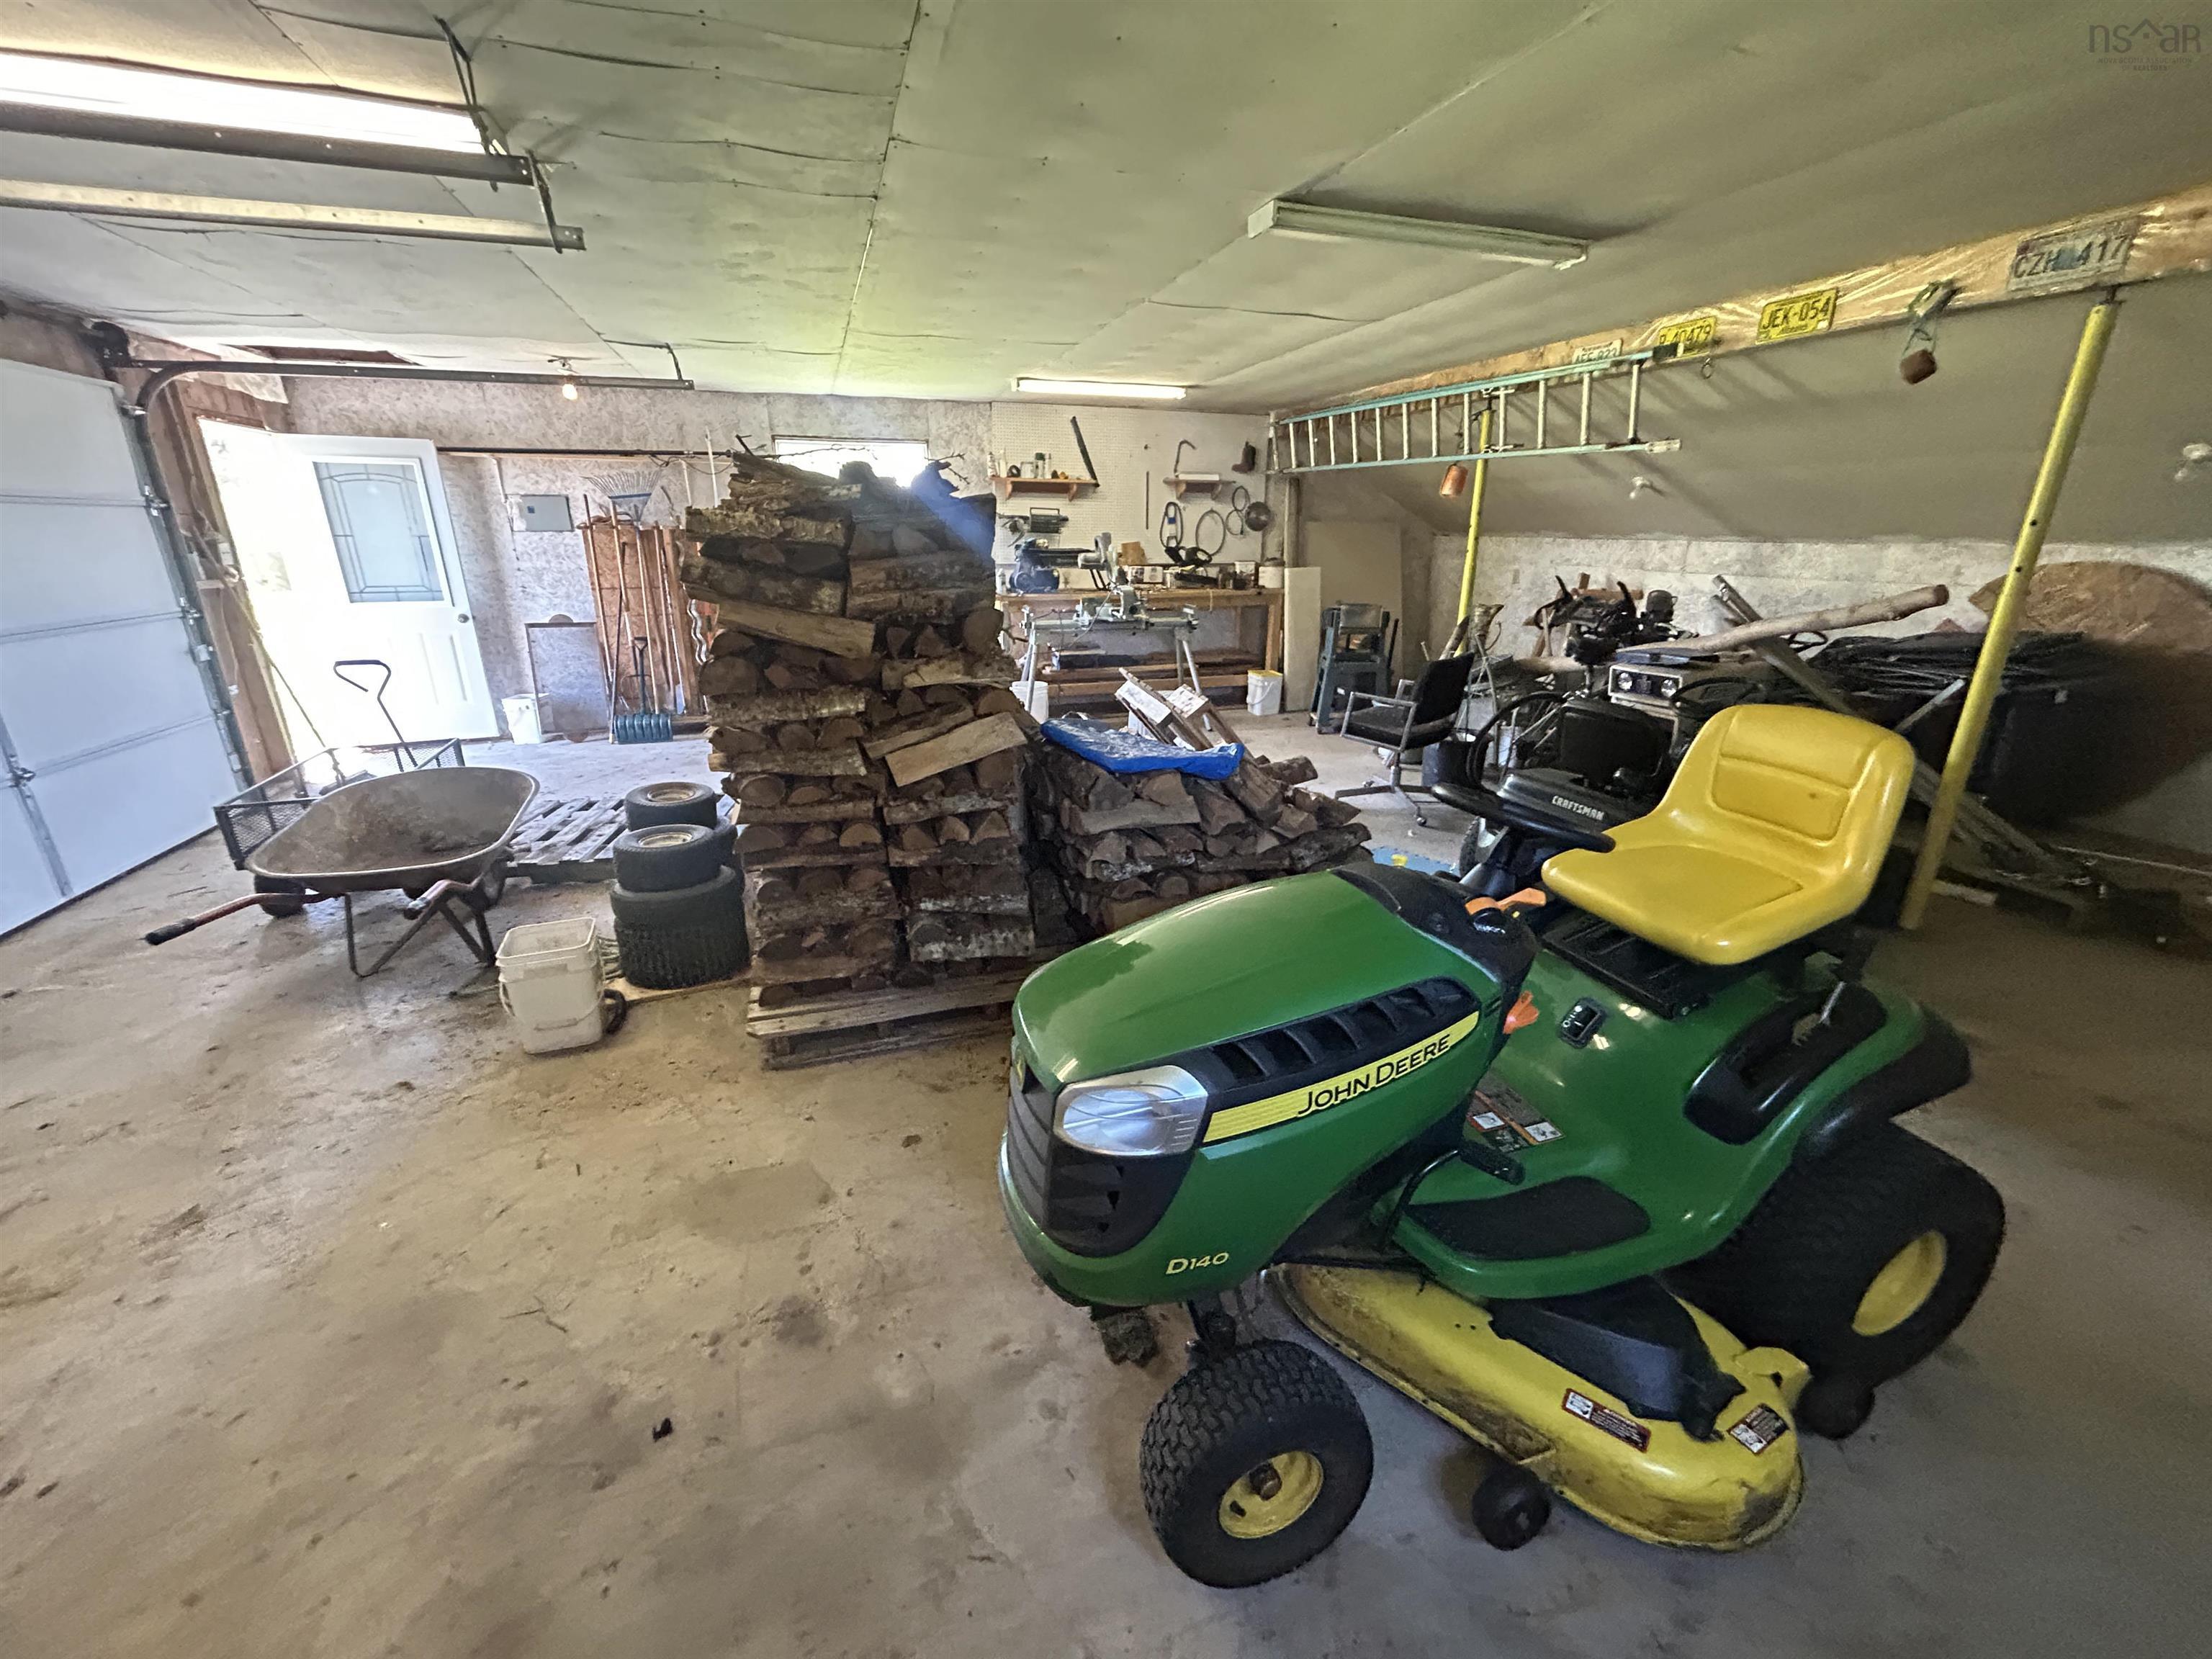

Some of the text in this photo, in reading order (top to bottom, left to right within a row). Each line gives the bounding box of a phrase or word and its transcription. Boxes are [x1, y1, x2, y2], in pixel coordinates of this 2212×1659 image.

[1762, 296, 1832, 330] JEK-054
[1552, 795, 1605, 821] CRAFTSMAN
[1298, 1033, 1451, 1115] JOHN DEERE
[1165, 1251, 1230, 1275] D140
